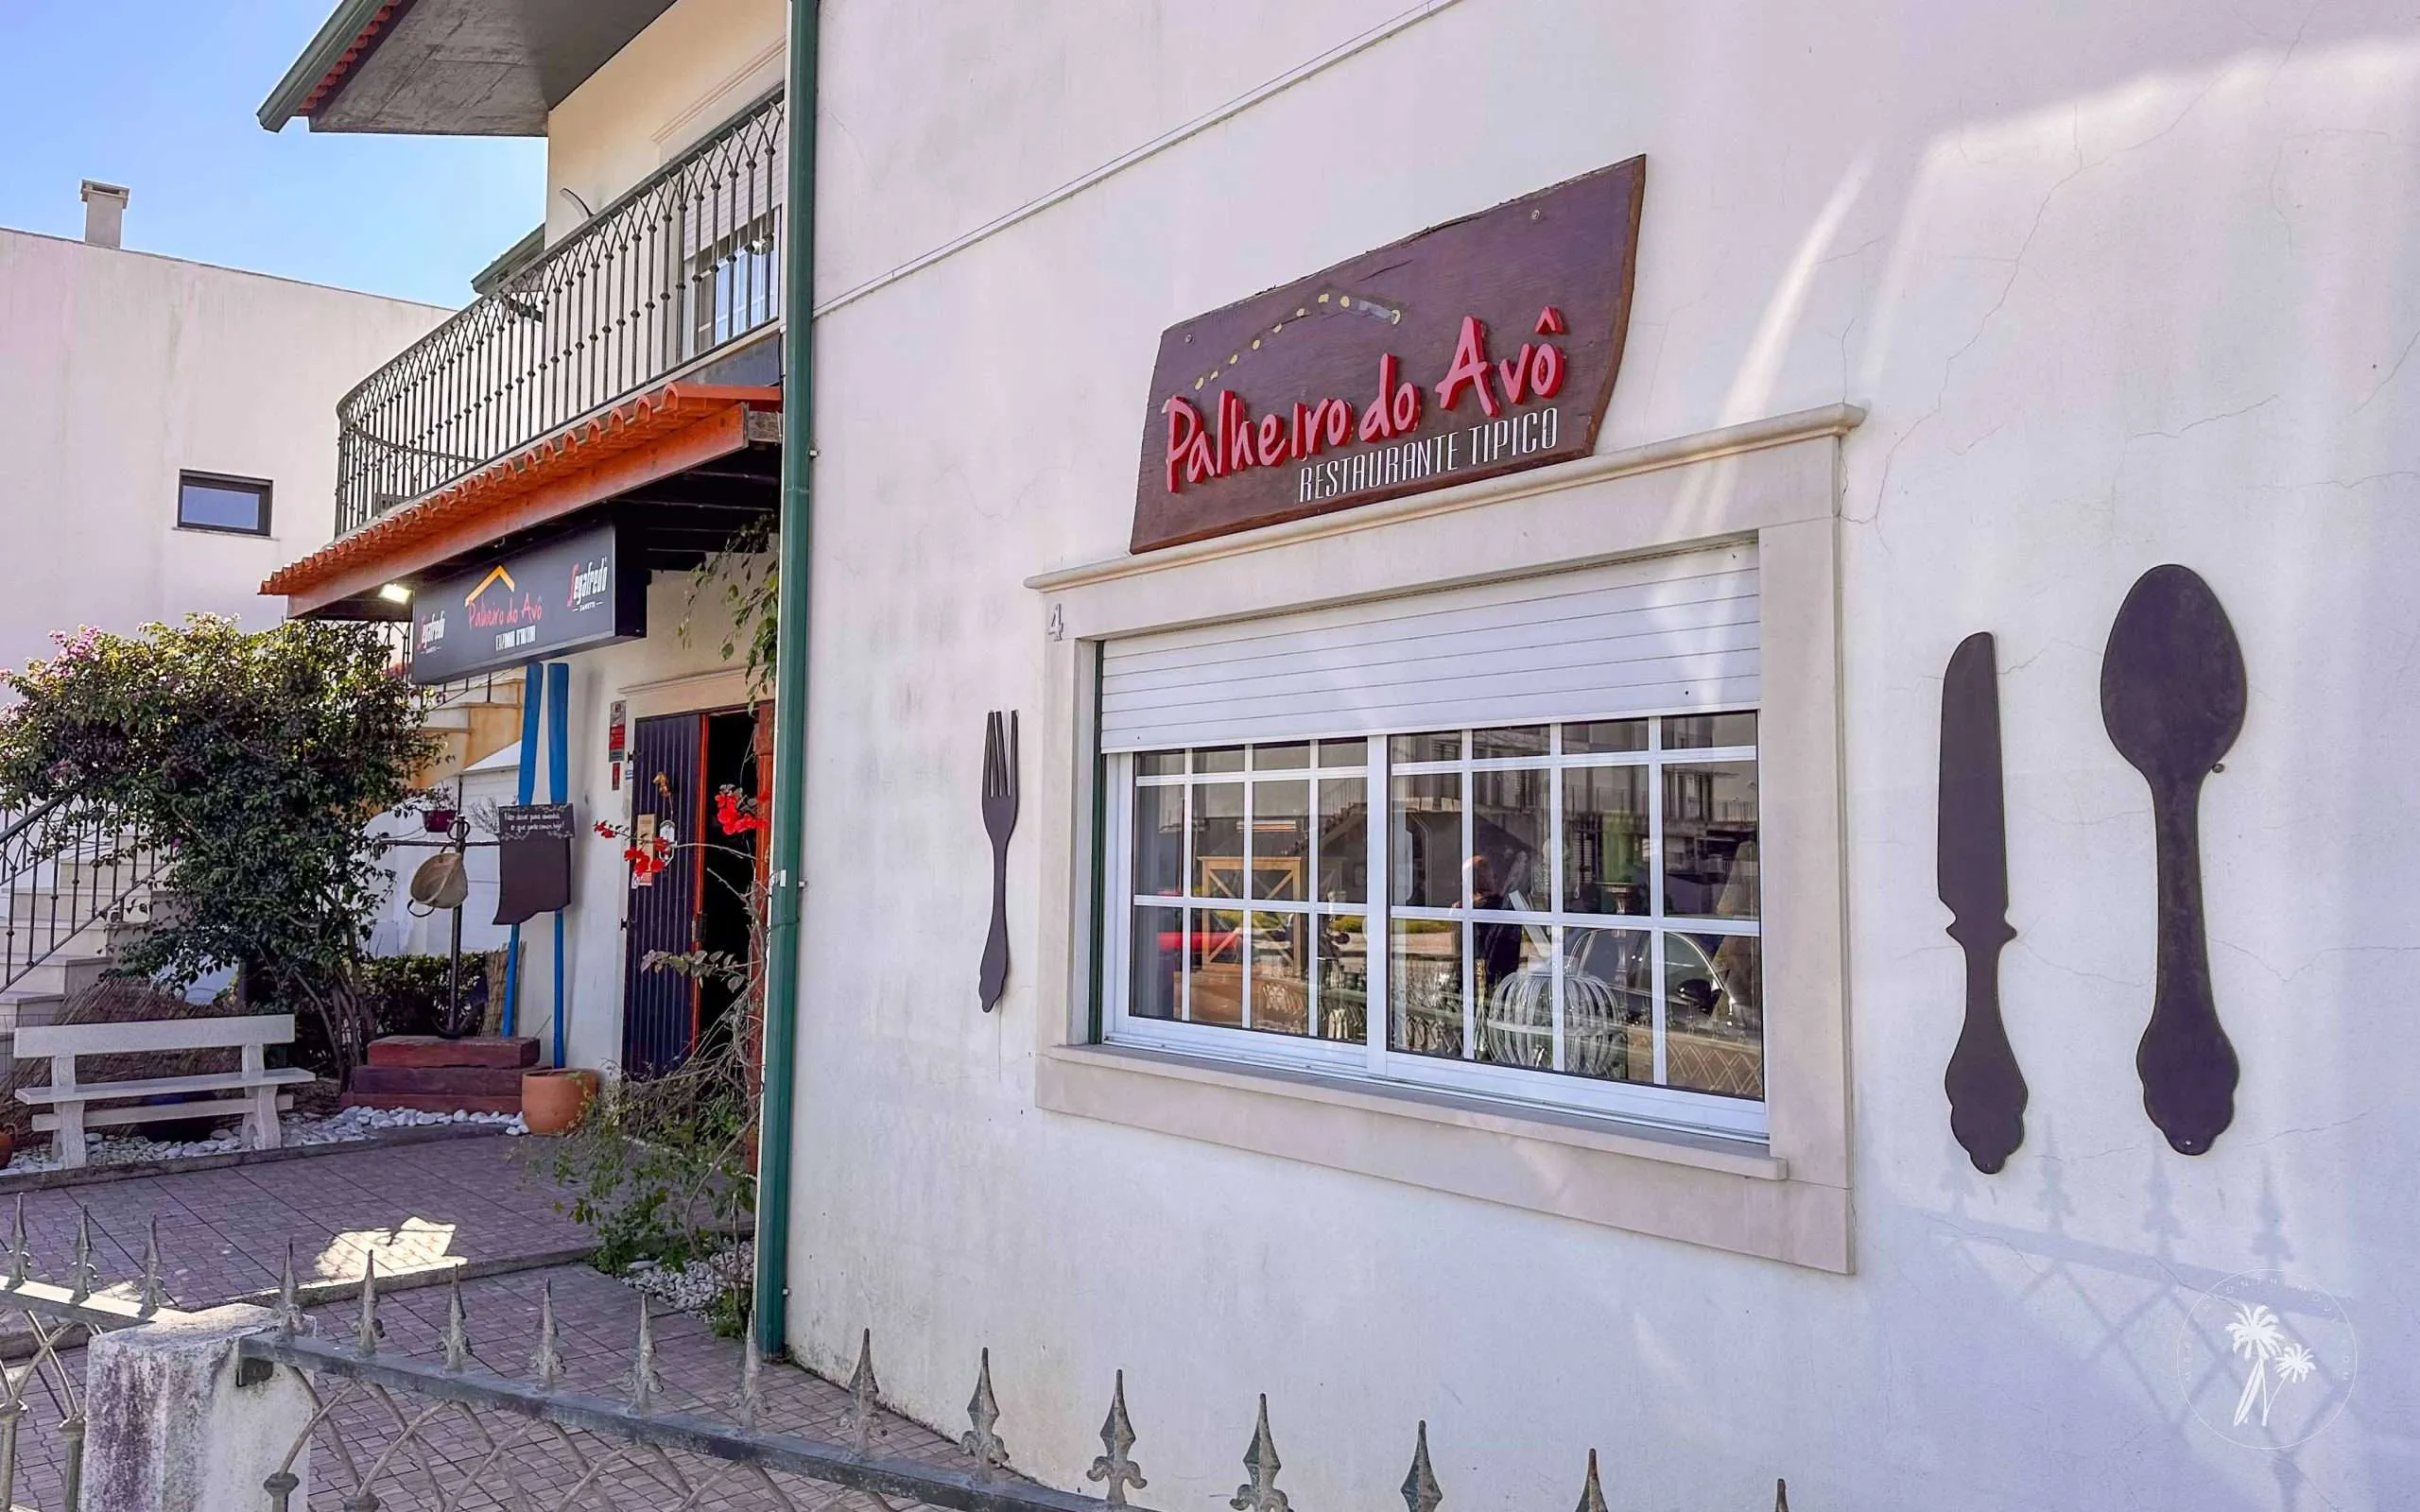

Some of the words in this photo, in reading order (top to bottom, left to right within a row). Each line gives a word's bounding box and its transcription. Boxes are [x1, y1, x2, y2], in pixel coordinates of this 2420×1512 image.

[1357, 352, 1422, 443] do
[1435, 305, 1566, 418] Avô
[1299, 431, 1461, 503] RESTAURANTE
[1467, 406, 1559, 466] TIPICO
[1047, 603, 1064, 643] 4
